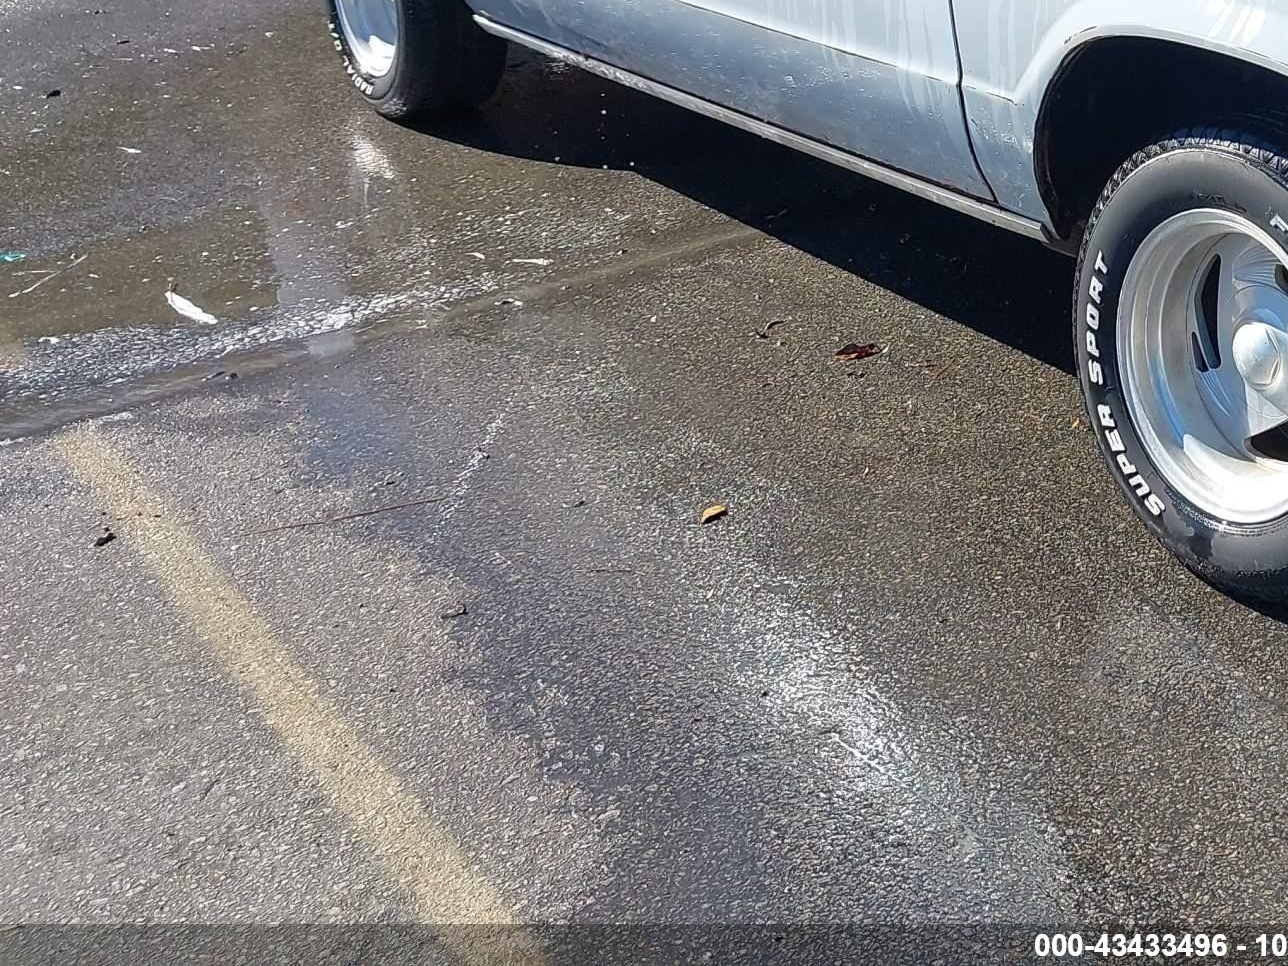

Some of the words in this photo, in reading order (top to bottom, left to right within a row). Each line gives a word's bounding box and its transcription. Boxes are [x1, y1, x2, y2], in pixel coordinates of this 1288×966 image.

[343, 55, 374, 95] RADIAL
[1086, 249, 1108, 385] SPORT
[1097, 403, 1166, 516] SUPER
